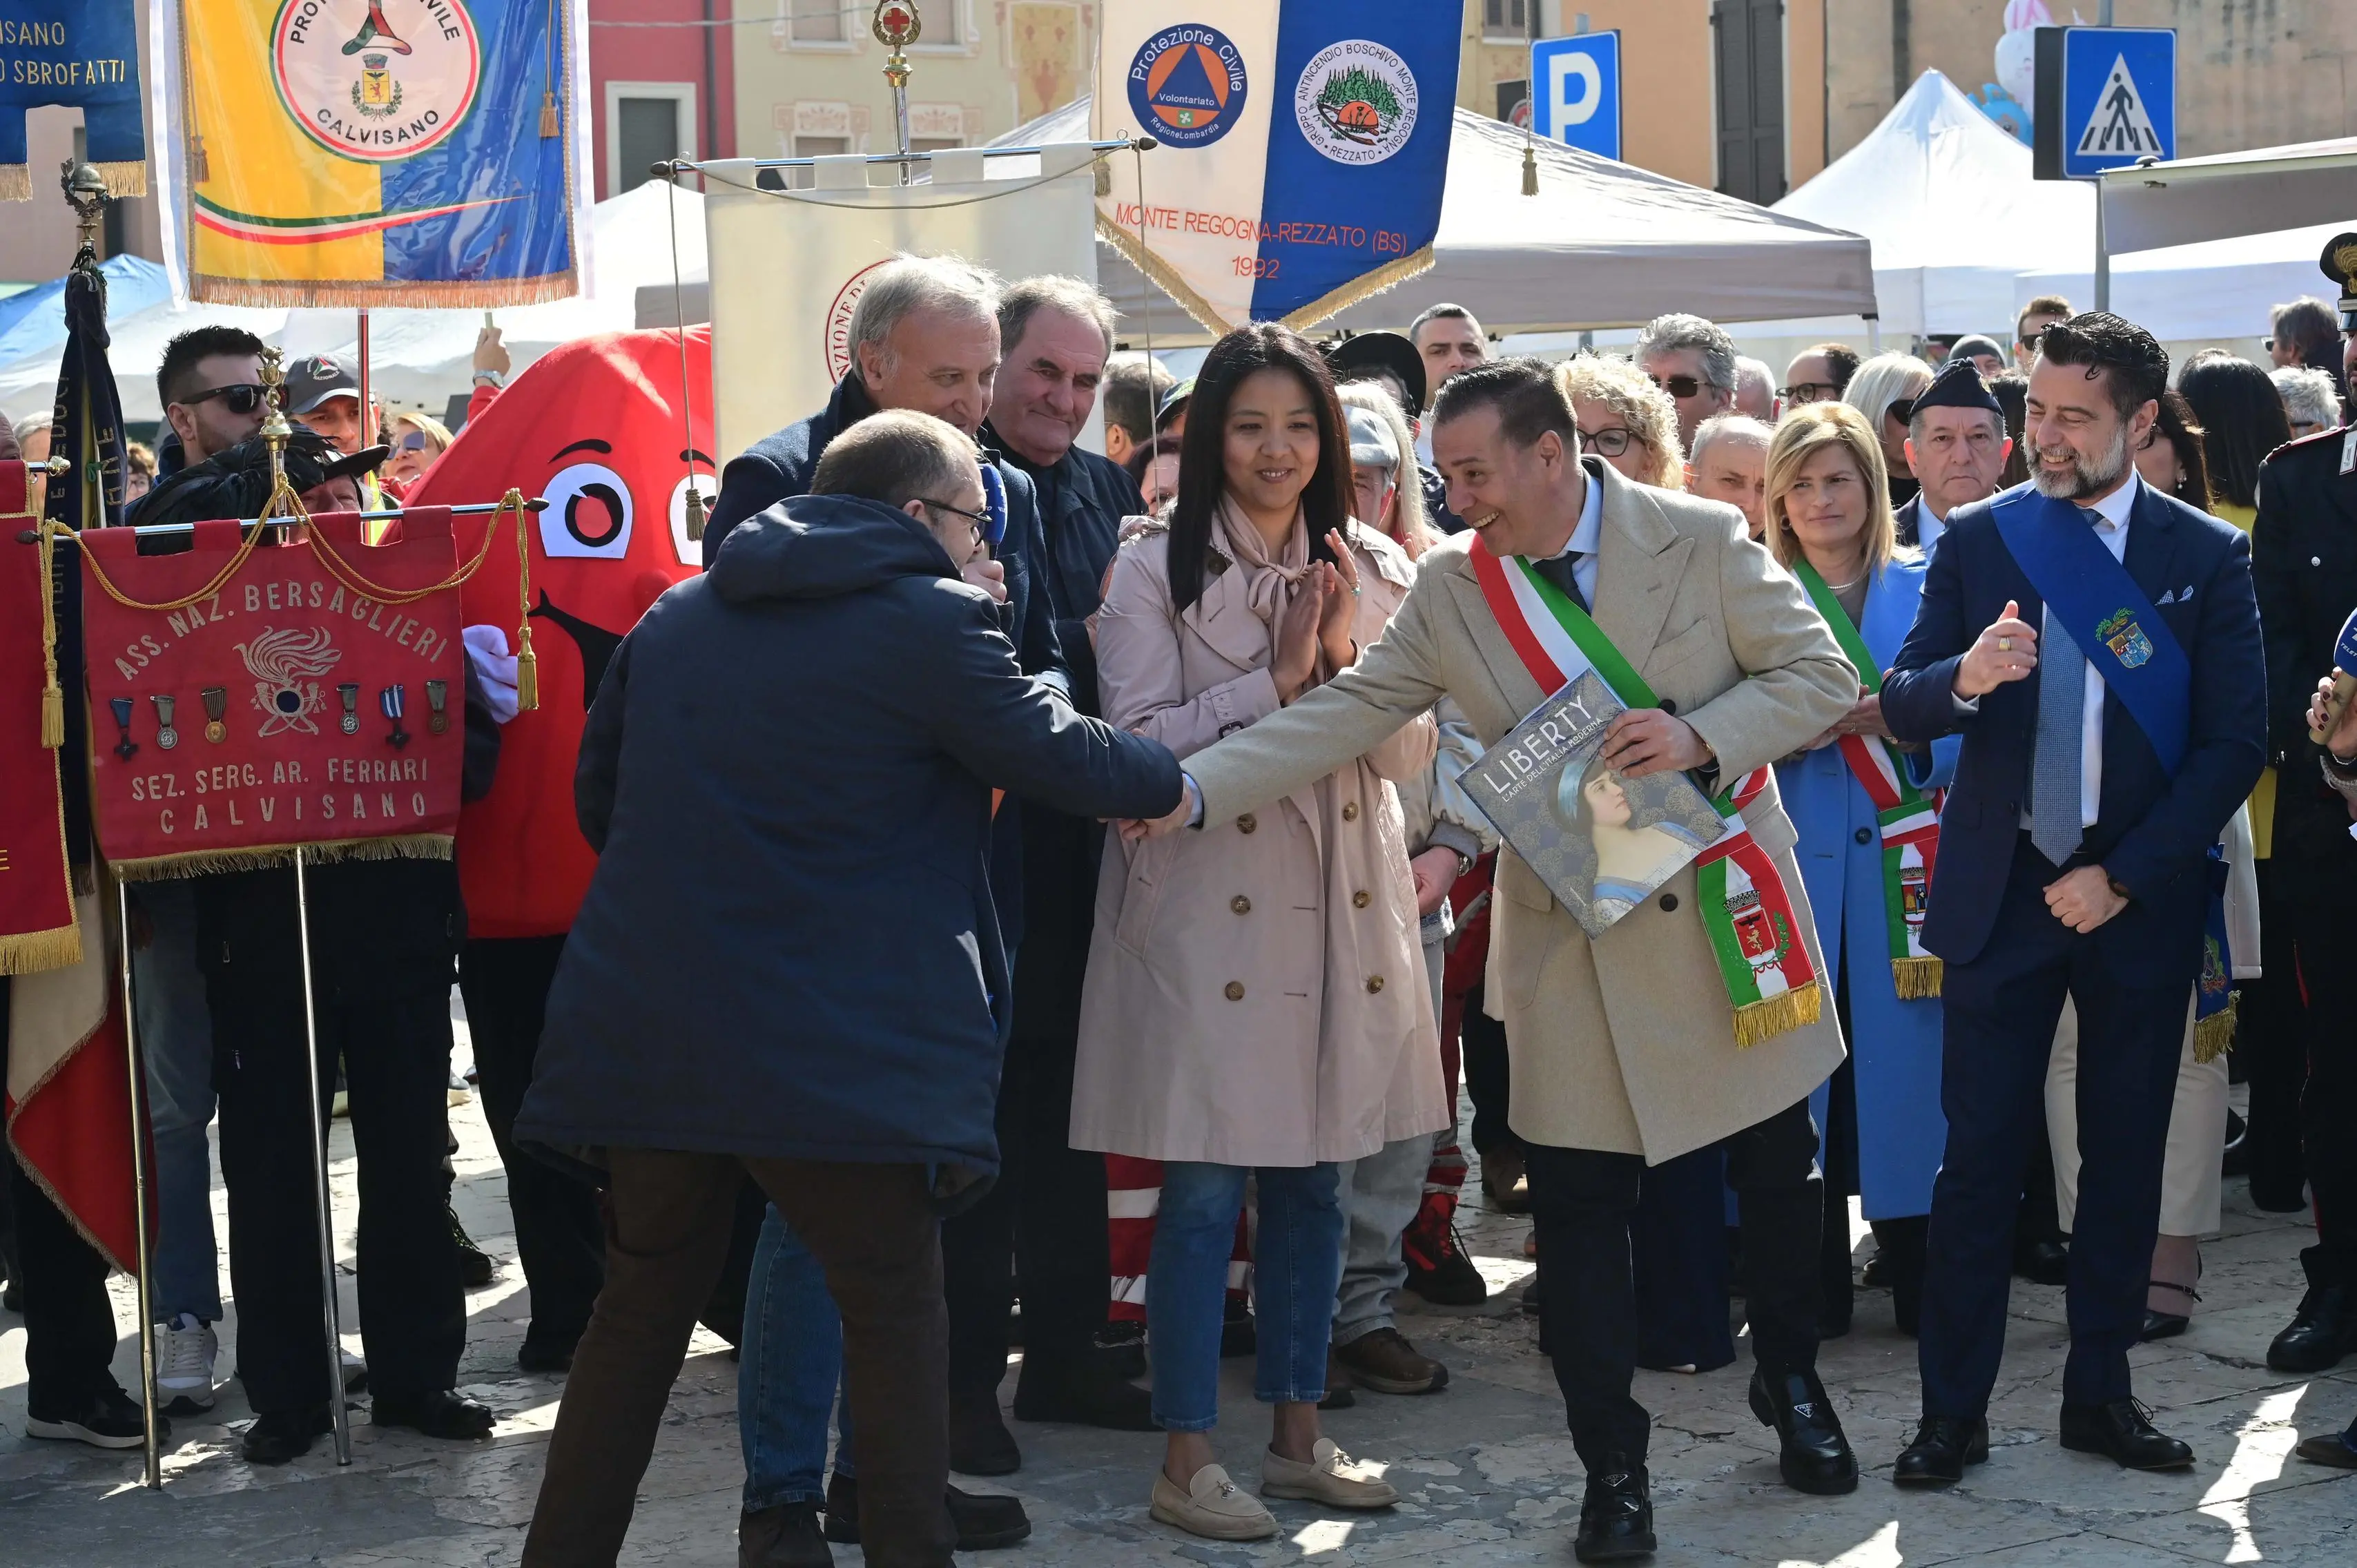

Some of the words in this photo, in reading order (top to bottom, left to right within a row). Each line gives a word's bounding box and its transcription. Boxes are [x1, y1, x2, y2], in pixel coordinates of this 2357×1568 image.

[290, 0, 327, 44] PRO
[420, 0, 460, 41] VILE
[14, 59, 125, 86] SBROFATTI
[1132, 28, 1214, 81] Protezione
[1219, 45, 1244, 91] Civile
[1298, 46, 1342, 101] ANTINCENDIO
[1346, 43, 1398, 68] BOSCHIVO
[1159, 93, 1214, 106] Volontariato
[1396, 68, 1416, 104] MONTE
[1549, 52, 1602, 144] P
[317, 109, 438, 145] CALVISANO
[1299, 106, 1325, 146] GRUPPO
[1382, 108, 1415, 153] REGOGNA
[1329, 145, 1375, 162] REZZATO
[1115, 203, 1178, 229] MONTE
[1372, 230, 1408, 256] (BS)
[1231, 255, 1281, 279] 1992
[313, 370, 340, 380] NAZIONALE
[115, 635, 169, 681] ASS.
[167, 592, 235, 638] NAZ.
[244, 581, 448, 664] BERSAGLIERI
[1483, 695, 1591, 794] LIBERTY
[132, 774, 185, 801] SEZ.
[195, 764, 263, 794] SERG.
[273, 761, 309, 784] AR.
[328, 758, 428, 784] FERRARI
[1502, 780, 1528, 802] L'ARTE
[1526, 746, 1569, 782] DELL'ITALIA
[160, 792, 426, 834] CALVISANO
